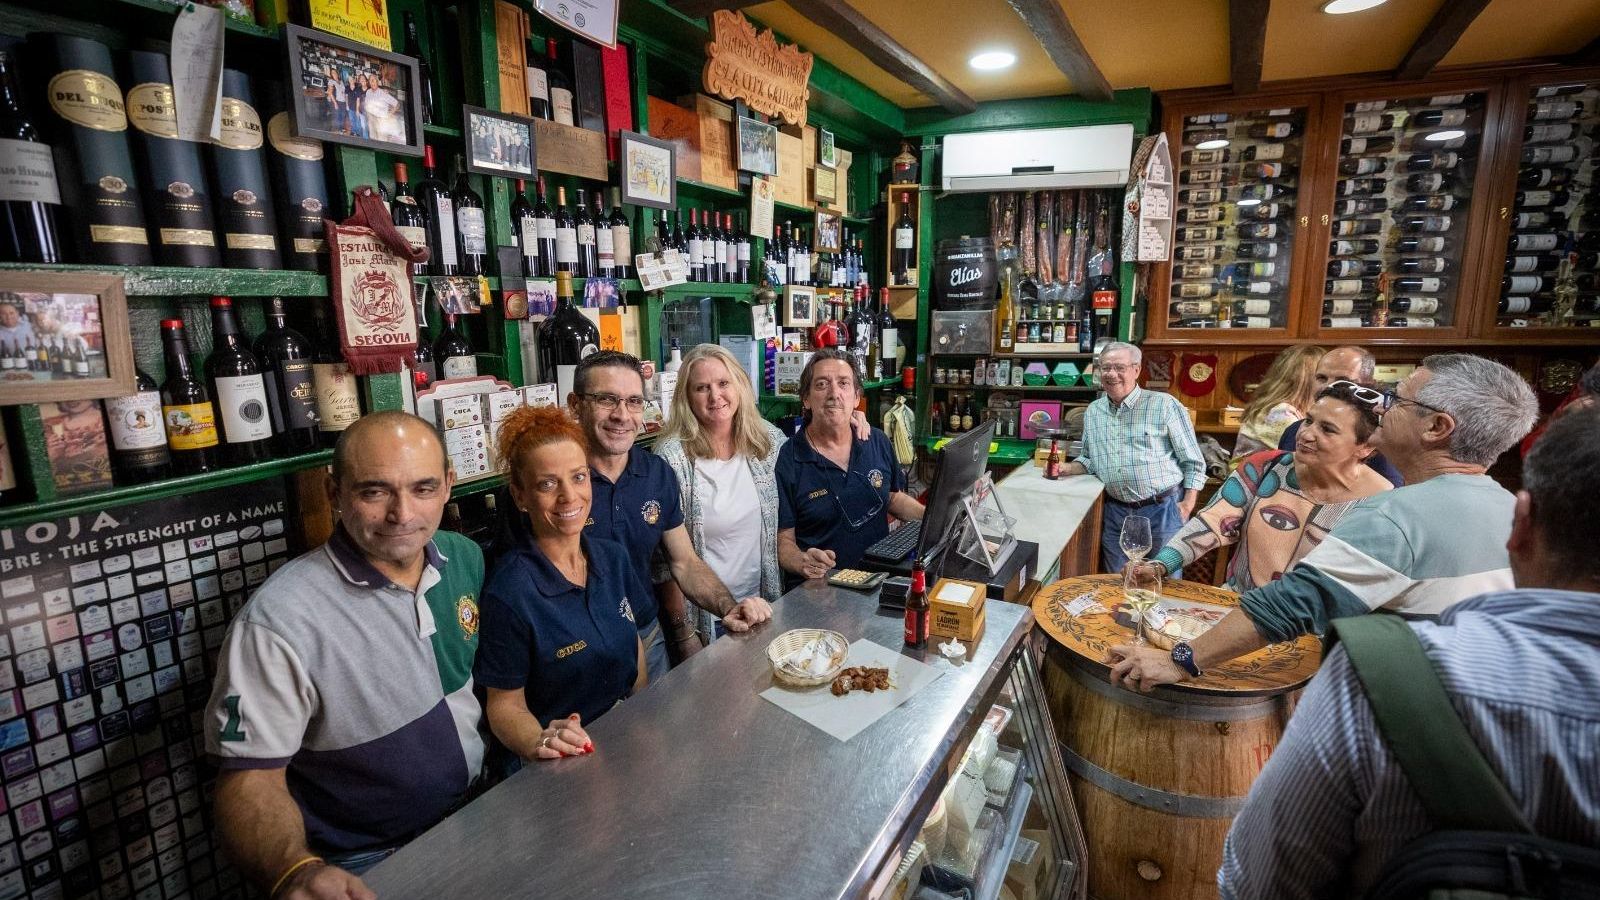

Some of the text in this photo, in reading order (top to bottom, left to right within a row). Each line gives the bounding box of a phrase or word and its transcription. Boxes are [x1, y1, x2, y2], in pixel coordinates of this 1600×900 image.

[56, 91, 84, 103] DEL
[950, 266, 983, 287] Elías
[355, 332, 411, 346] SEGOVIA
[1, 501, 285, 573] BRE THE STRENGHT OF A NAME
[219, 695, 246, 742] 1
